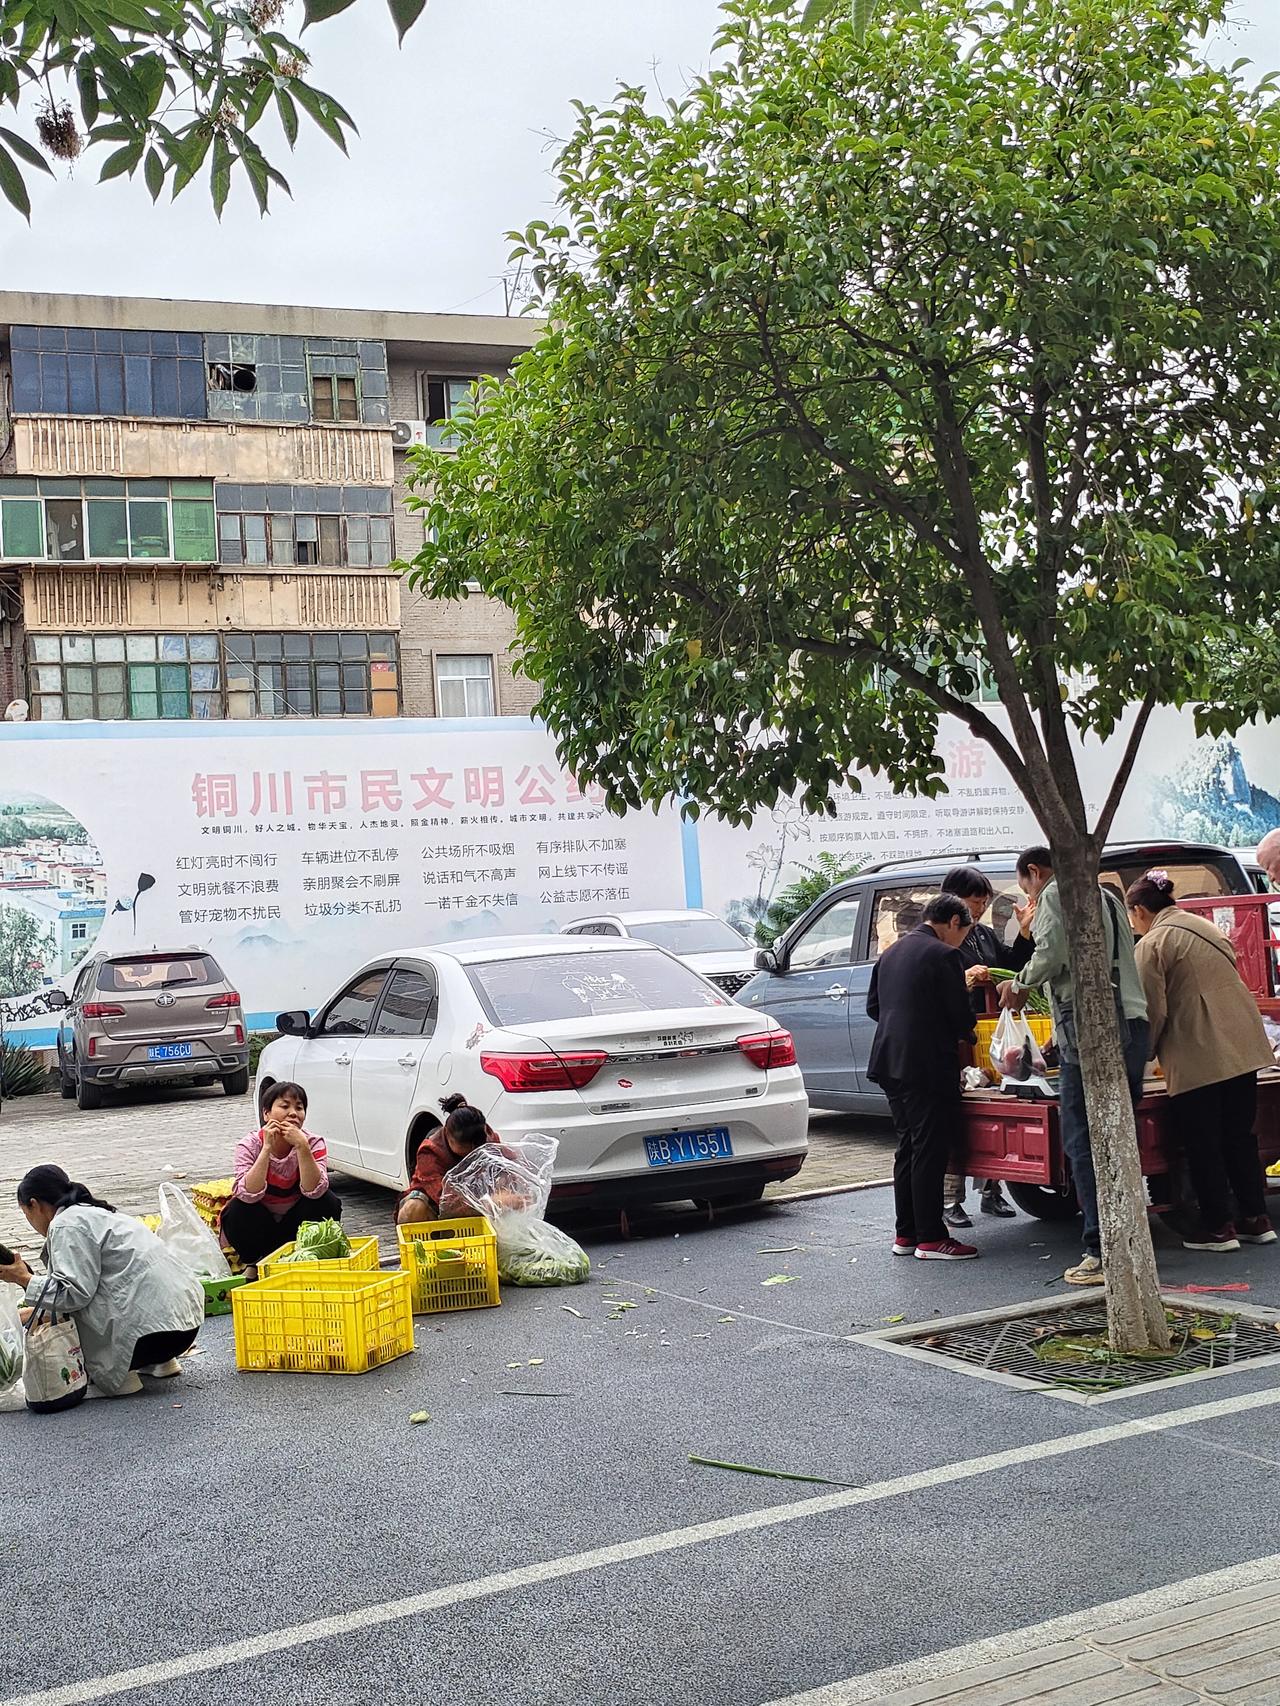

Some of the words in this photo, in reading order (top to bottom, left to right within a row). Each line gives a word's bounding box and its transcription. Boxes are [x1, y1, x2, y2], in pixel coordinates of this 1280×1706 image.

[948, 739, 986, 779] 游
[421, 842, 515, 859] 公共场所不吸烟
[536, 838, 627, 854] 有序排队不加塞
[175, 853, 278, 870] 红灯亮时不闯行
[301, 848, 399, 865] 车辆进位不乱停
[423, 868, 517, 885] 说话和气不高声
[538, 862, 629, 879] 网上线下不传谣
[177, 879, 279, 897] 文明就餐不浪费
[302, 874, 400, 891] 亲朋聚会不刷屏
[424, 893, 518, 910] 一诺千金不失信
[540, 887, 630, 904] 公益志愿不落伍
[179, 905, 281, 924] 管好宠物不扰民
[304, 900, 402, 917] 垃圾分类不乱扔
